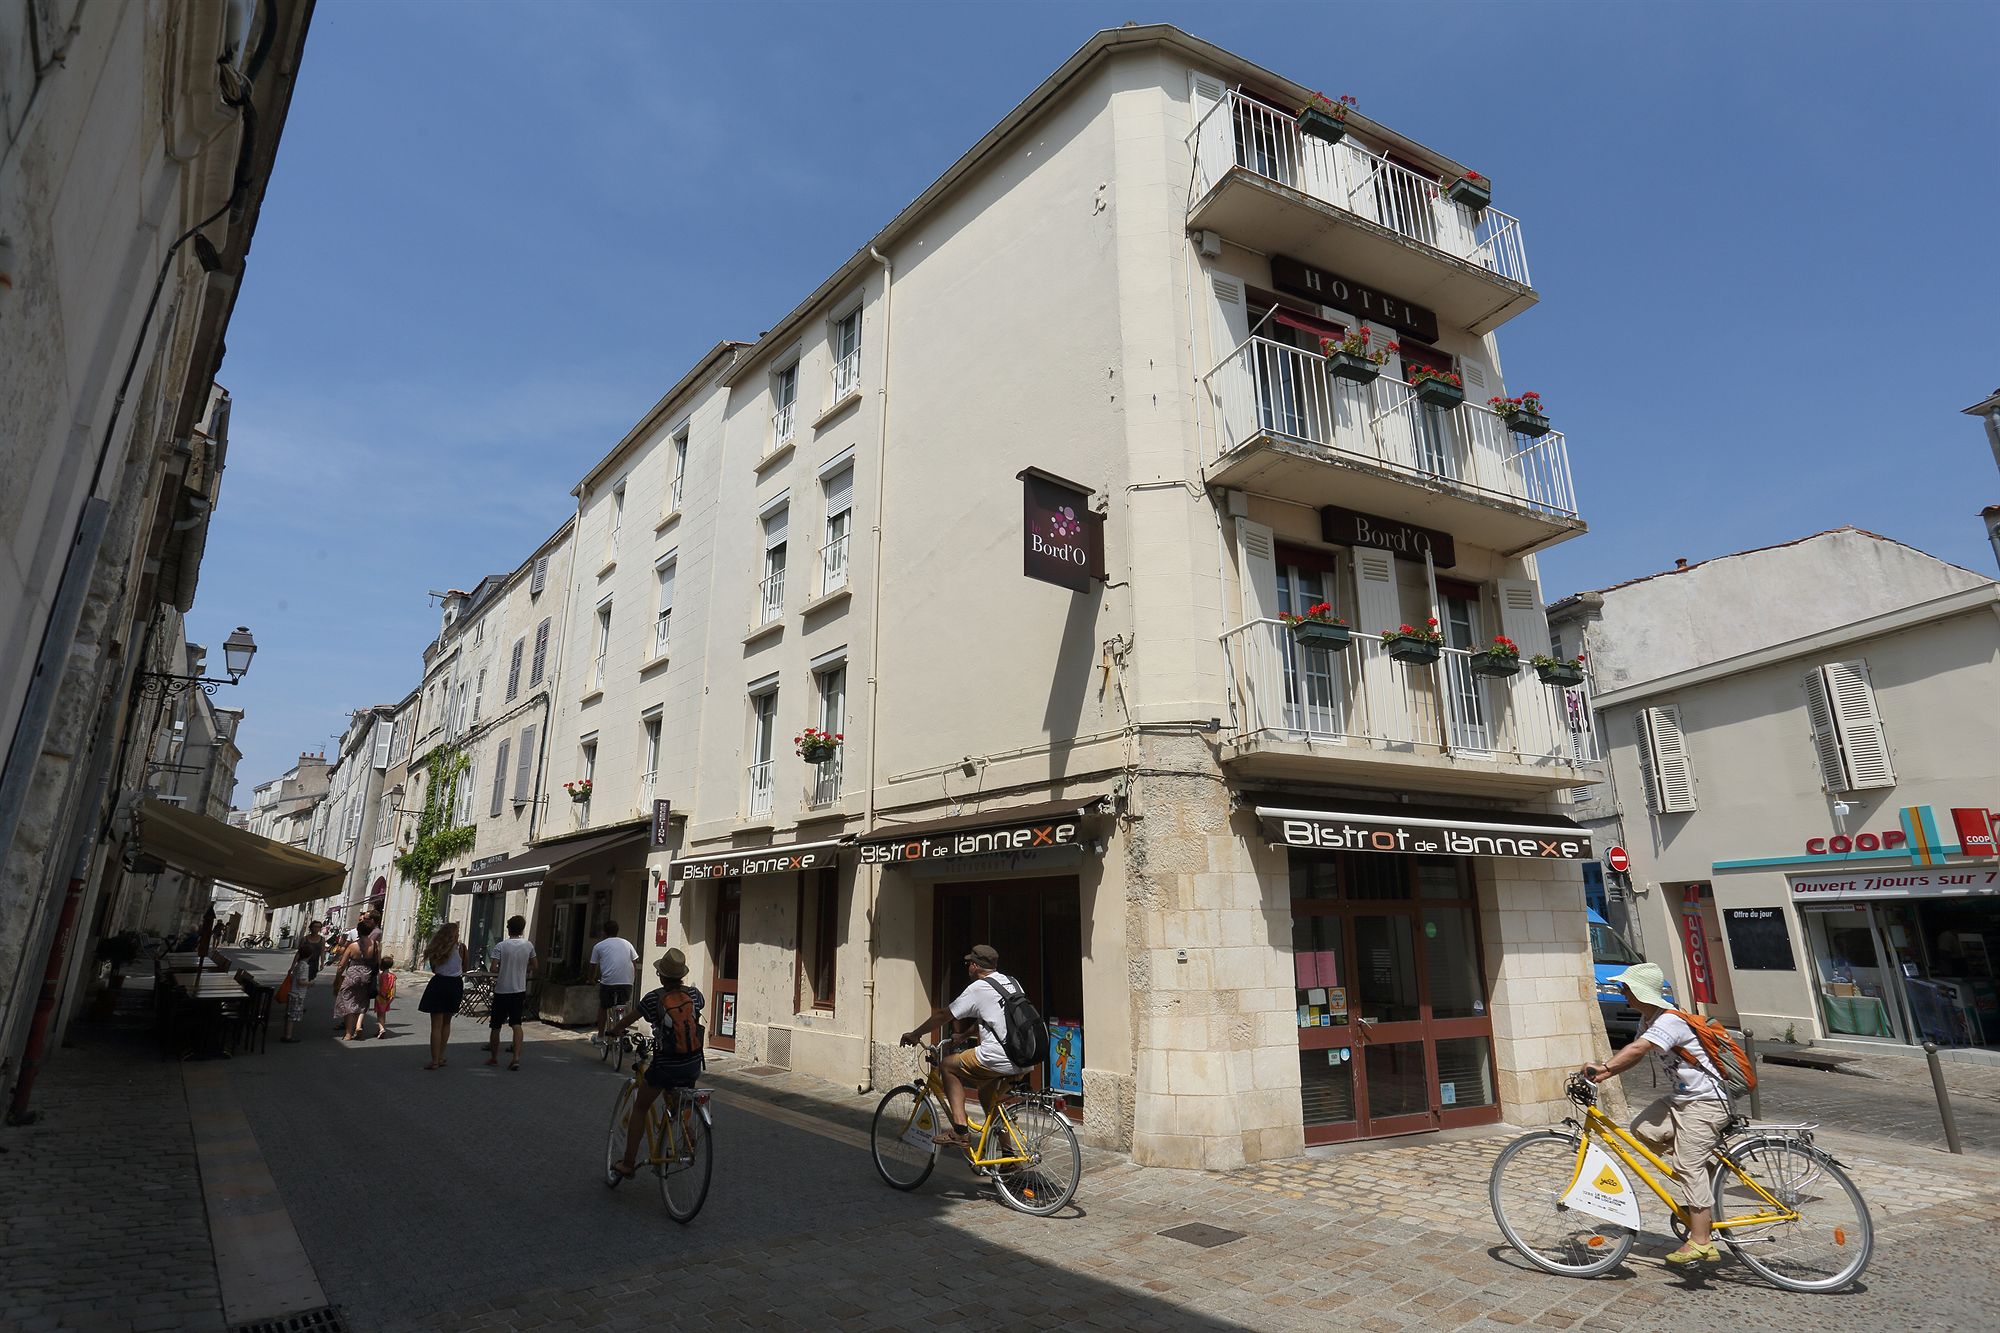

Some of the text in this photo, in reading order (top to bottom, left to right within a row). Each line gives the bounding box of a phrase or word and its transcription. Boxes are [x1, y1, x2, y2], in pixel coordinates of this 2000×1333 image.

[1304, 269, 1417, 327] HOTEL
[1031, 533, 1086, 566] Bord'O
[1355, 516, 1431, 557] Bord'O
[861, 824, 1075, 864] Bistrot de l'annexe
[1283, 820, 1579, 858] Bistrot de l'annexe
[1806, 830, 1906, 855] COOP
[1966, 835, 1990, 843] COOP
[683, 854, 815, 879] Bistrot de l'annexe
[1794, 880, 1857, 893] Ouvert
[1938, 873, 1977, 886] sur
[1985, 871, 1998, 883] 7
[1759, 910, 1773, 919] jour
[1687, 914, 1707, 984] COOP
